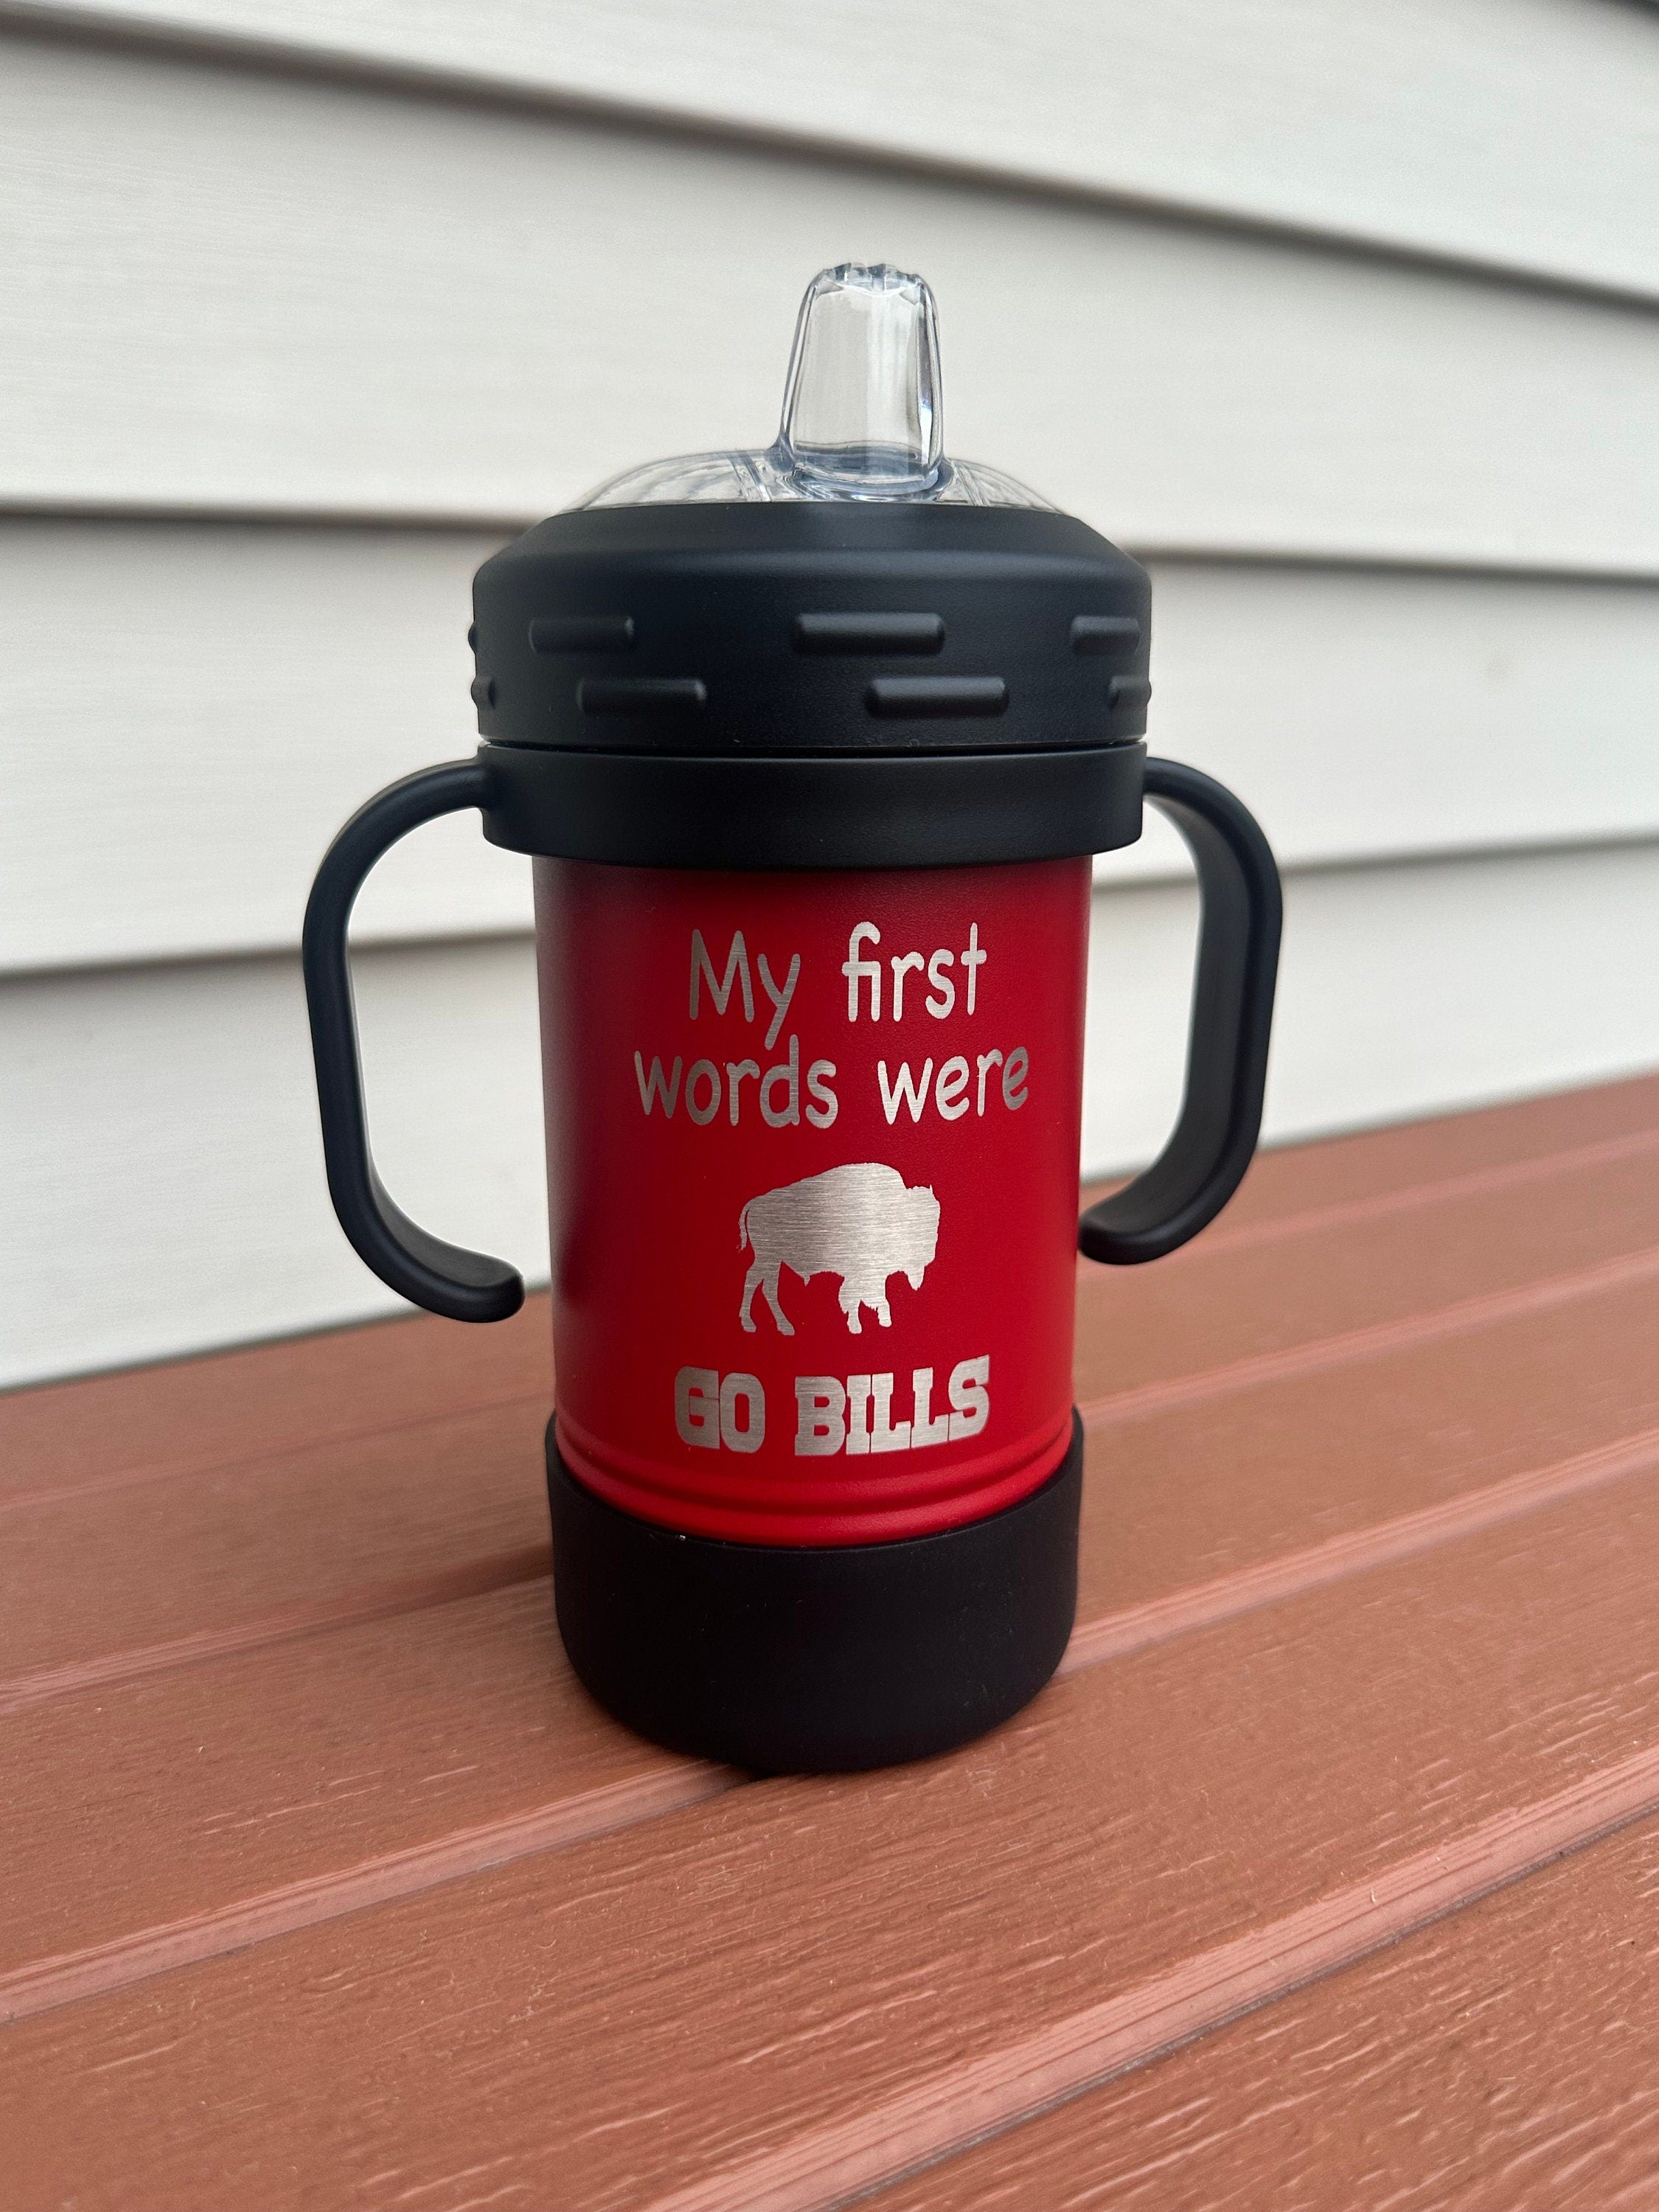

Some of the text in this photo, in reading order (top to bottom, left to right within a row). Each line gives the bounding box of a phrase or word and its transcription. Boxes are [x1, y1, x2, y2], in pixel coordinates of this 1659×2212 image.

[689, 921, 988, 1051] My first
[633, 1034, 1029, 1129] words were
[673, 1354, 990, 1457] GO BILLS
